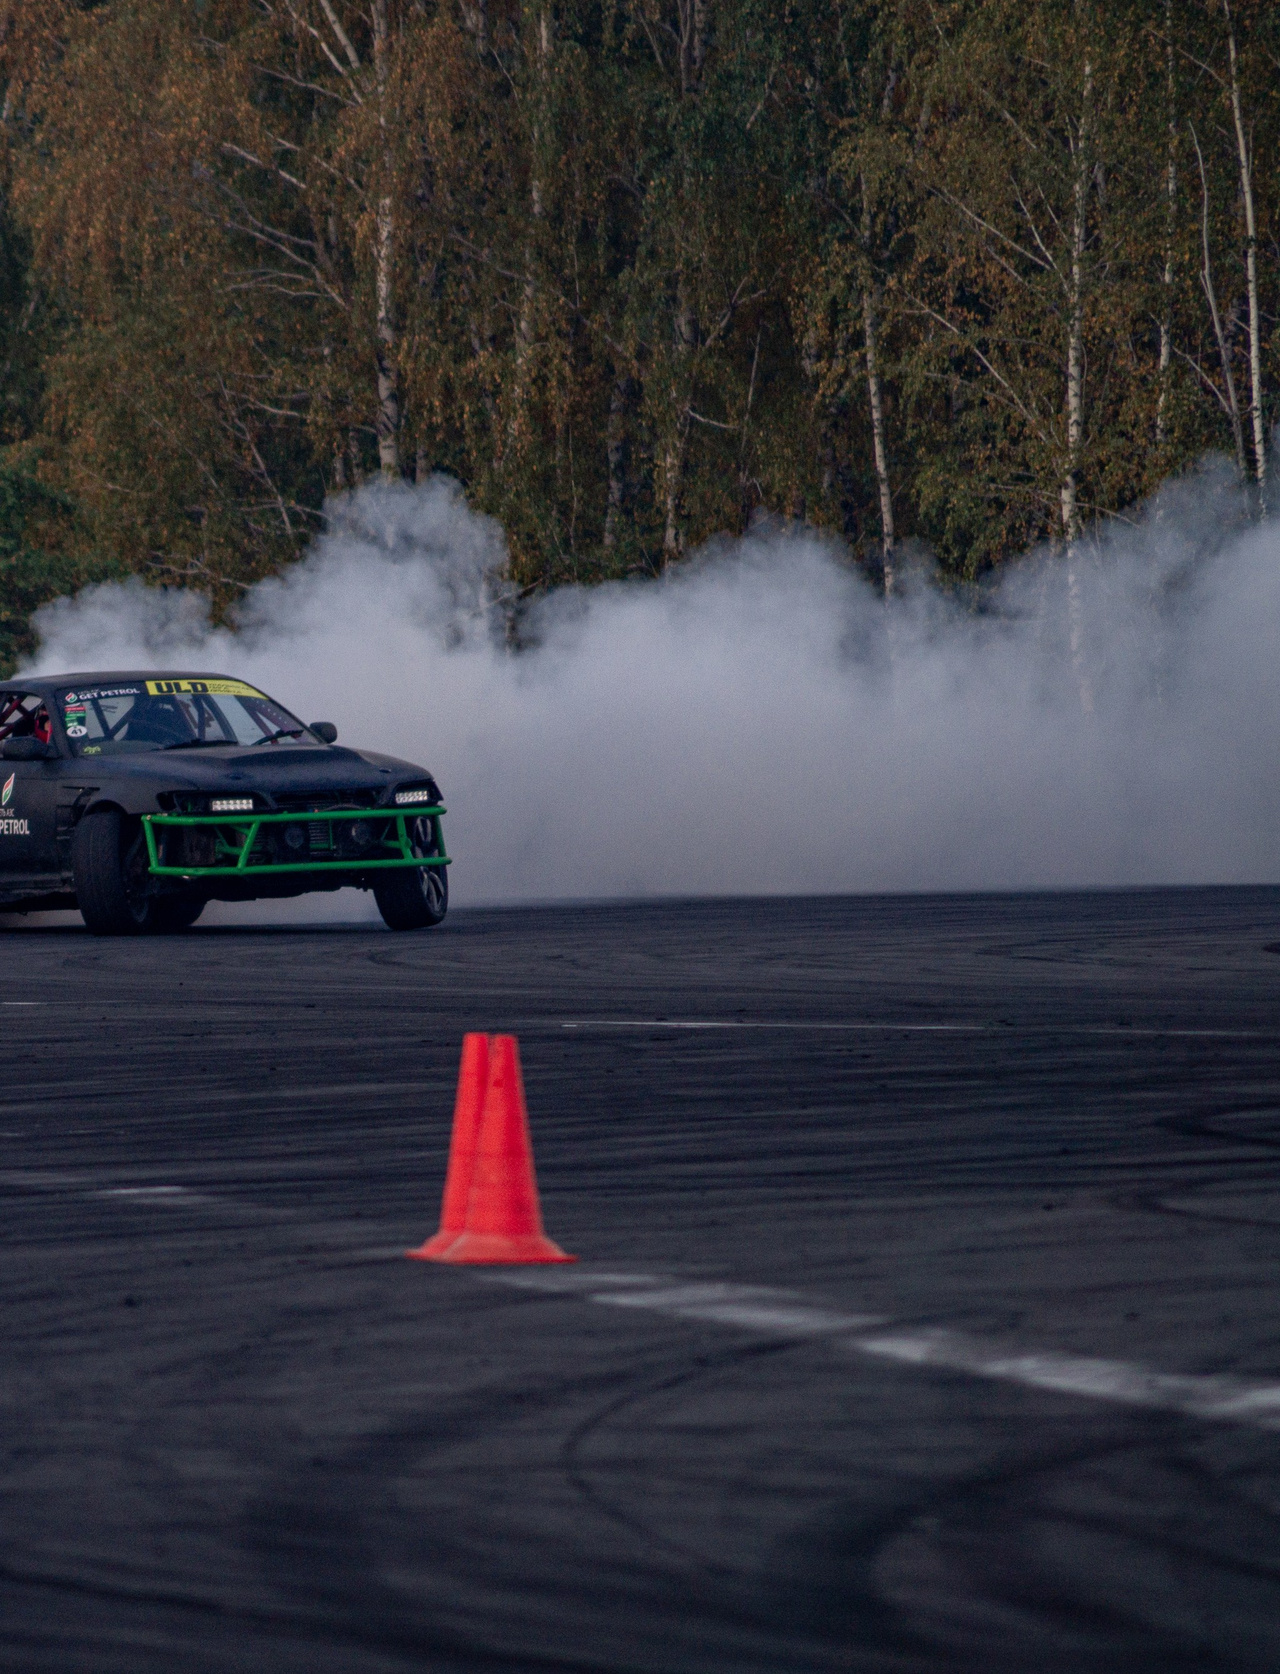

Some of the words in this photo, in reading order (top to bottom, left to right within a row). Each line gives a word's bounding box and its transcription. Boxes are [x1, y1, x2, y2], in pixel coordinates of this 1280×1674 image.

[79, 691, 99, 700] GET
[100, 688, 141, 697] PETROL
[154, 682, 209, 694] ULD
